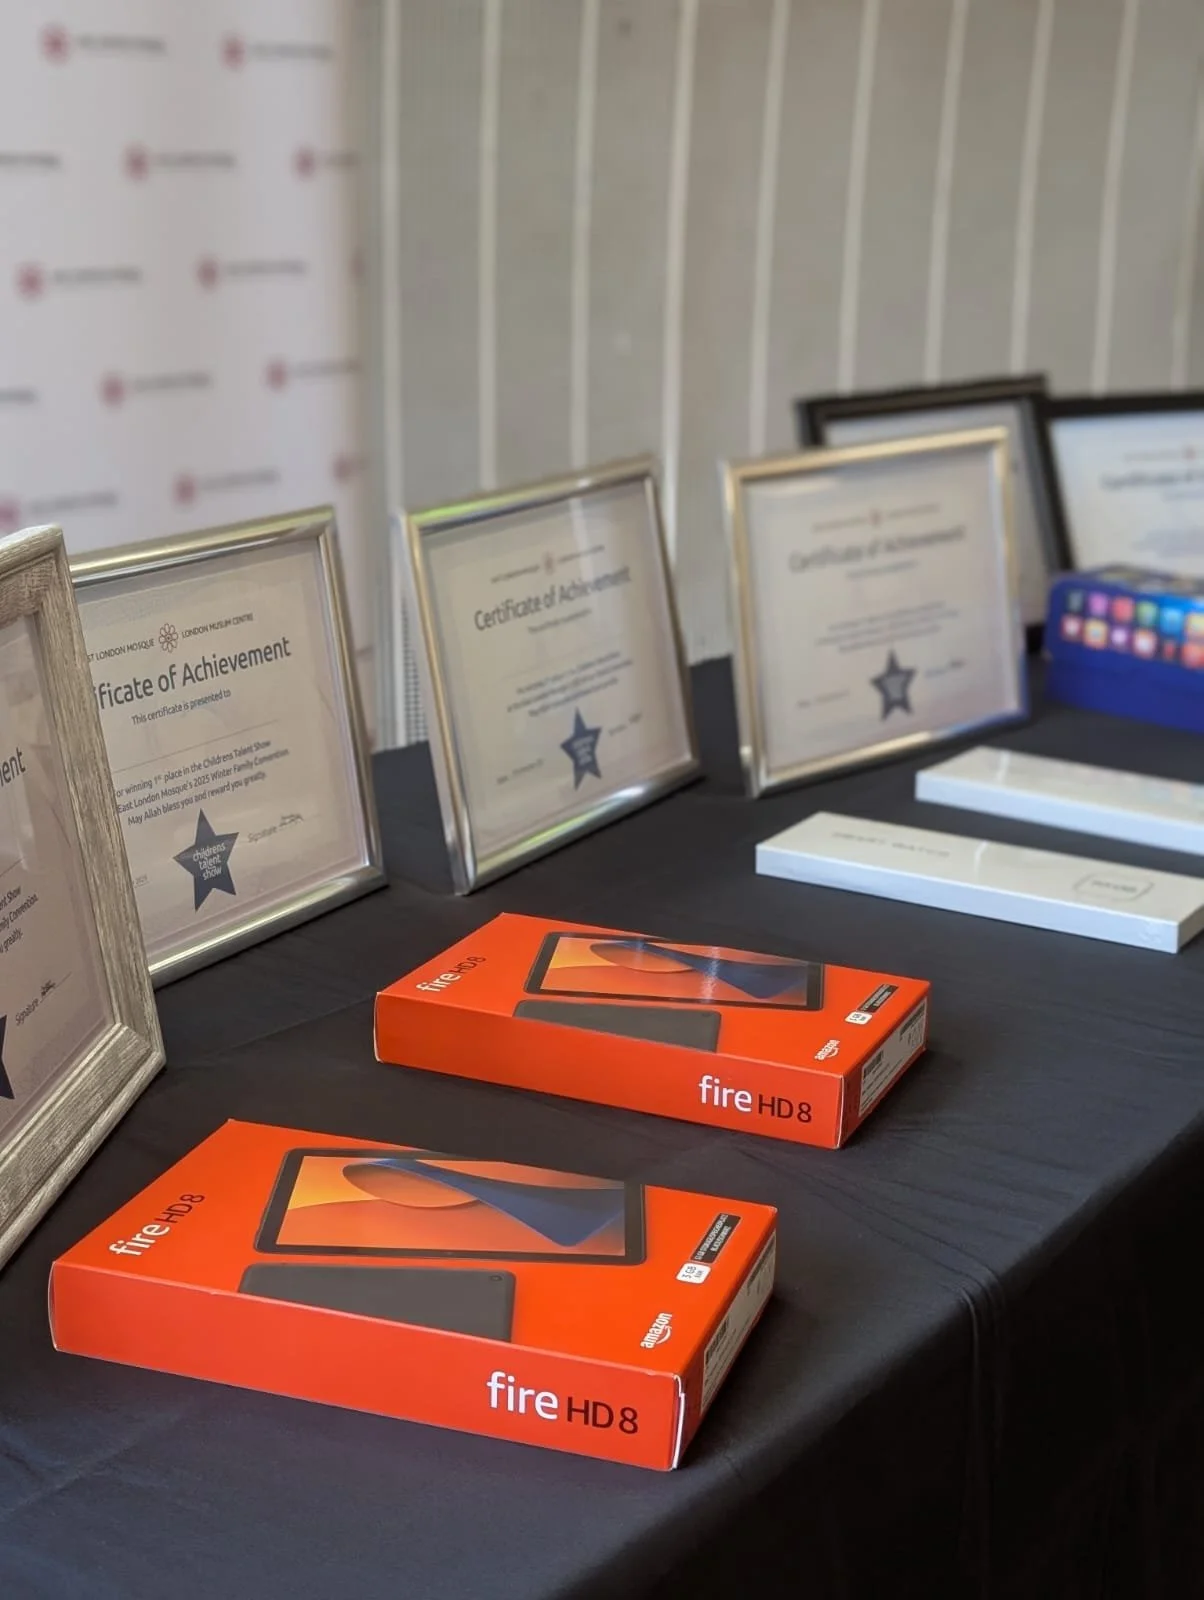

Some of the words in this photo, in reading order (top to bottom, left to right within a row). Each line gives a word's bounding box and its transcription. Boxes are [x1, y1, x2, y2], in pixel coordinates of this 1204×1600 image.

[474, 596, 541, 632] Certificate
[544, 584, 556, 608] of
[182, 624, 208, 638] LONDON
[96, 646, 126, 661] LONDON
[127, 638, 155, 653] MOSQUE
[158, 664, 177, 692] of
[182, 636, 292, 687] Achievement
[132, 713, 147, 725] This
[148, 702, 182, 720] certificate
[184, 702, 190, 711] is
[190, 688, 223, 710] presented
[224, 688, 232, 698] to
[125, 780, 152, 795] winning
[164, 770, 182, 784] place
[182, 766, 190, 776] in
[190, 762, 202, 773] the
[134, 792, 160, 808] London
[160, 780, 193, 798] Mosque's
[194, 774, 210, 788] 2025
[210, 767, 232, 782] Winter
[128, 814, 143, 826] May
[144, 807, 162, 820] Allah
[162, 801, 180, 812] bless
[180, 796, 194, 809] you
[194, 789, 207, 802] and
[230, 780, 242, 792] you
[192, 842, 226, 862] childrens
[198, 854, 221, 870] talent
[202, 867, 222, 880] show
[416, 973, 462, 992] fire
[448, 962, 478, 974] HD
[698, 1075, 752, 1112] fire
[758, 1094, 794, 1119] HD
[798, 1102, 812, 1123] 8
[109, 1224, 170, 1256] fire
[154, 1203, 192, 1224] HD
[180, 1194, 205, 1203] 8
[640, 1312, 672, 1348] amazon
[486, 1370, 558, 1420] fire
[567, 1396, 614, 1428] HD
[618, 1407, 638, 1434] 8
